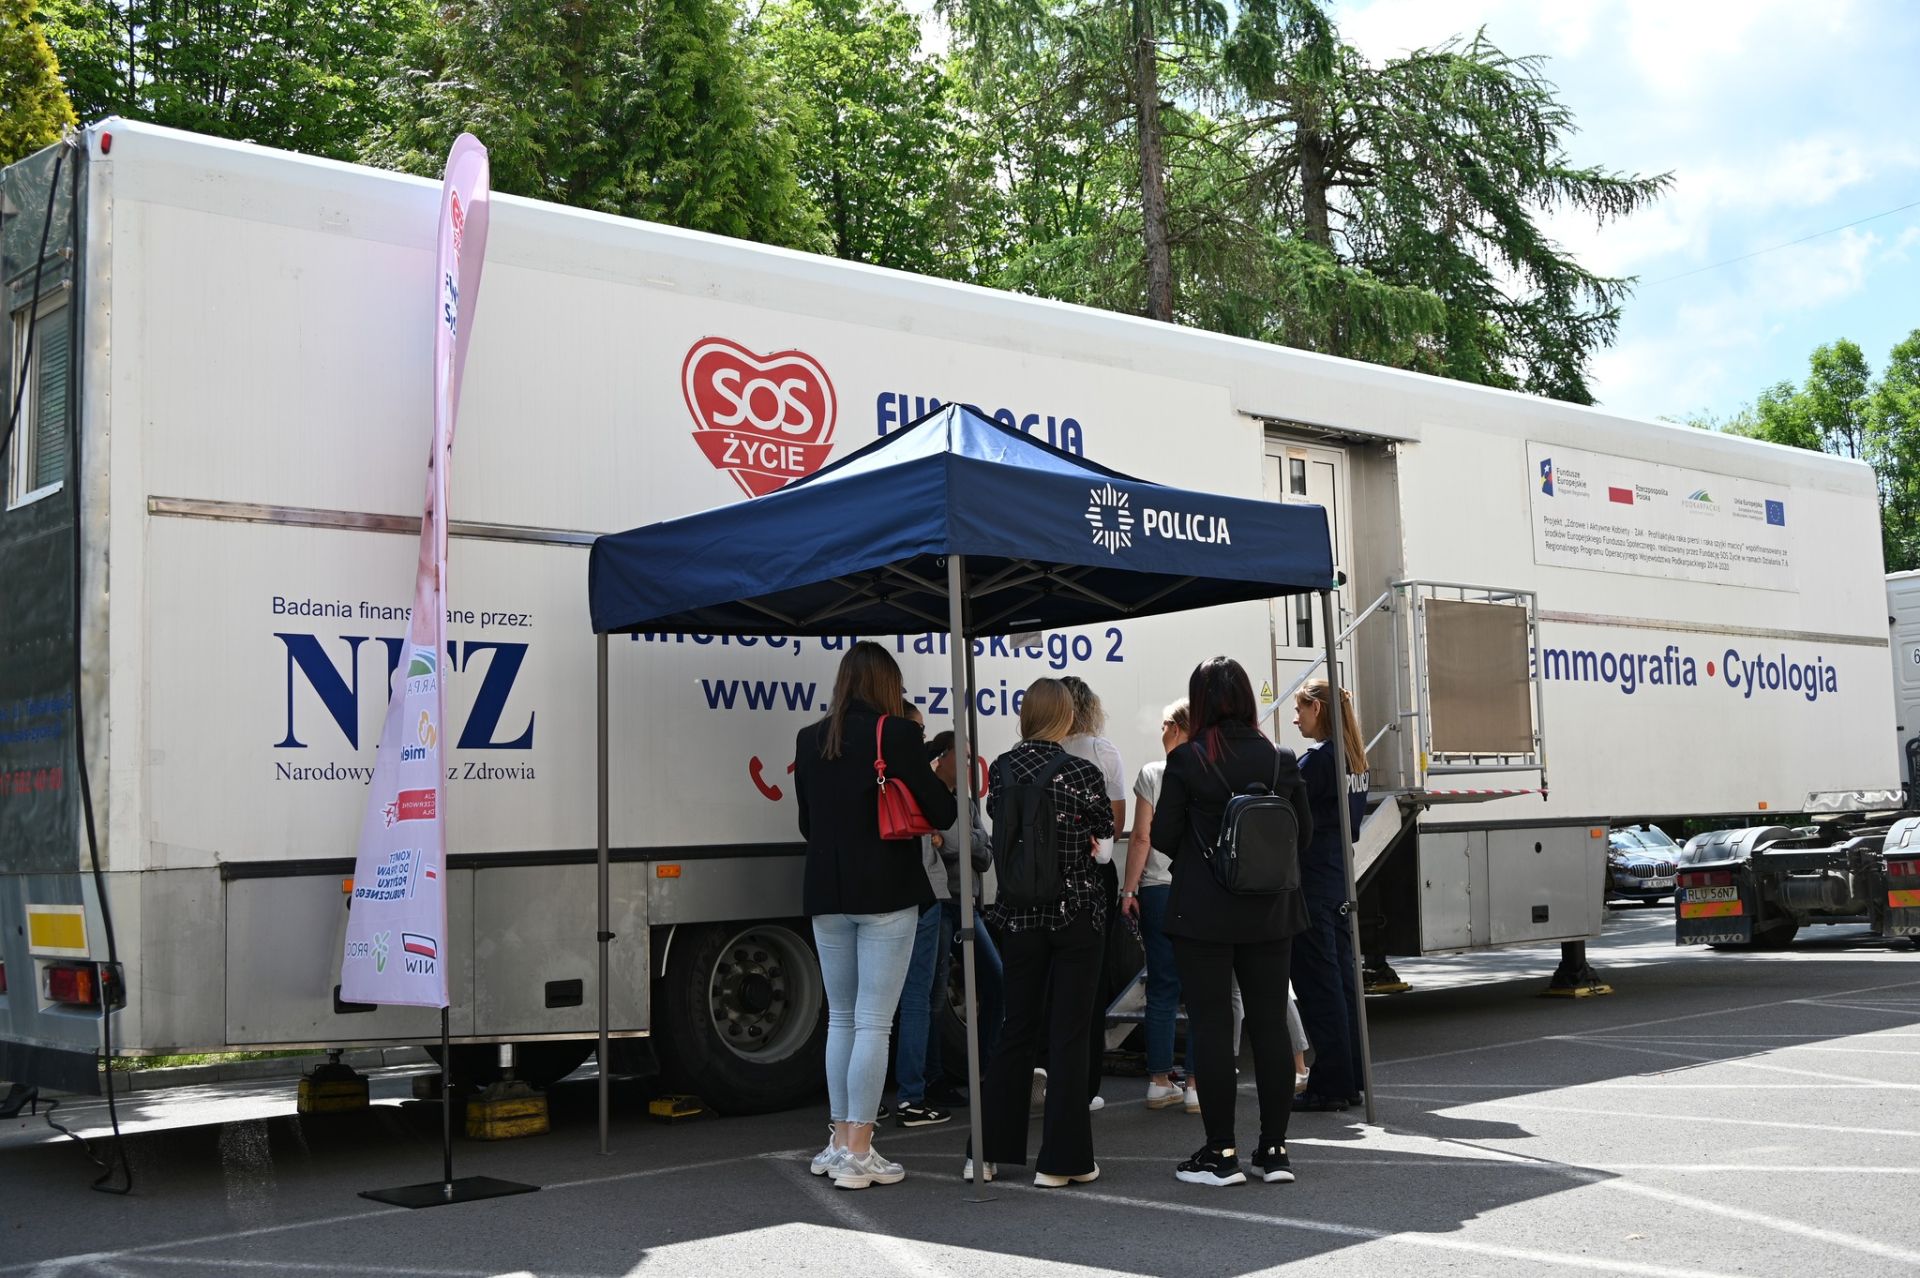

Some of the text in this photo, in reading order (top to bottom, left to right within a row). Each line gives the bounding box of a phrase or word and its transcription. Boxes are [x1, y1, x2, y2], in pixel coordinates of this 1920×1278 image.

[711, 367, 814, 435] SOS
[722, 433, 805, 471] ŻYCIE
[1556, 467, 1580, 479] Fundusze
[1143, 508, 1232, 545] POLICJA
[272, 596, 533, 629] Badania finansane przez:
[1105, 627, 1124, 663] 2
[1530, 645, 1838, 702] mmografia Cytologia
[275, 762, 375, 786] Narodowy
[464, 762, 535, 781] Zdrowia
[1687, 887, 1735, 900] RLU 56N7
[1681, 933, 1744, 945] VOLVO
